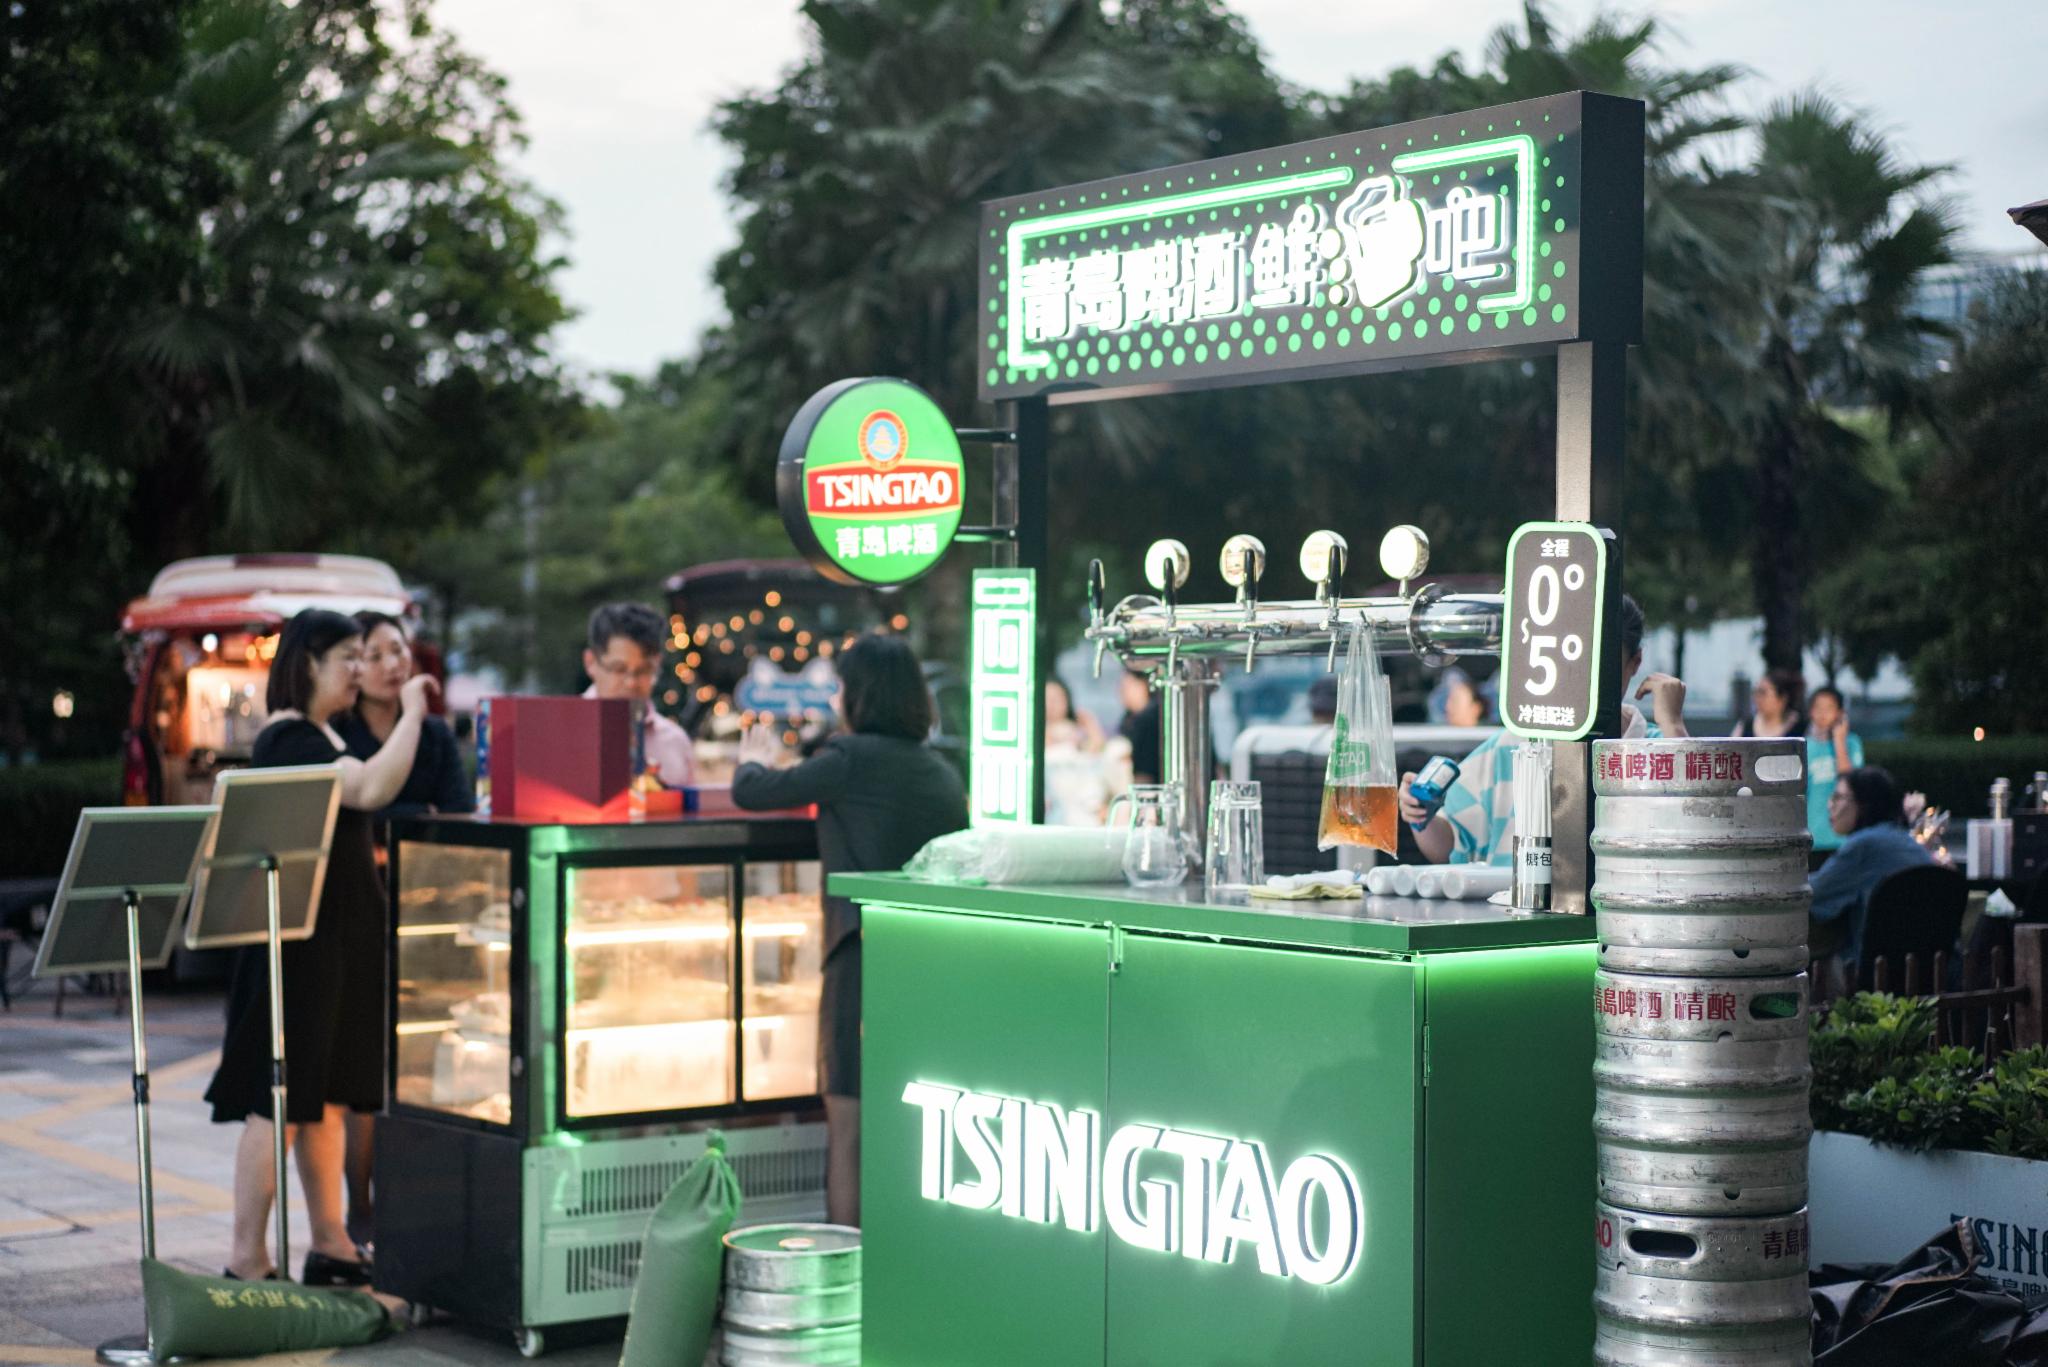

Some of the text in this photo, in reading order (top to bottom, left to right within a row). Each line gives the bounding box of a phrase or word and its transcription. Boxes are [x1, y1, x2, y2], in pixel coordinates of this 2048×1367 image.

[816, 470, 953, 508] TSINGTAO
[1541, 538, 1570, 557] 全程
[1518, 704, 1575, 727] 冷链配送
[1685, 751, 1744, 781] 精酿
[1674, 992, 1737, 1021] 精酿
[901, 1079, 1364, 1286] TSINGTAO
[1950, 1212, 2048, 1280] SIN
